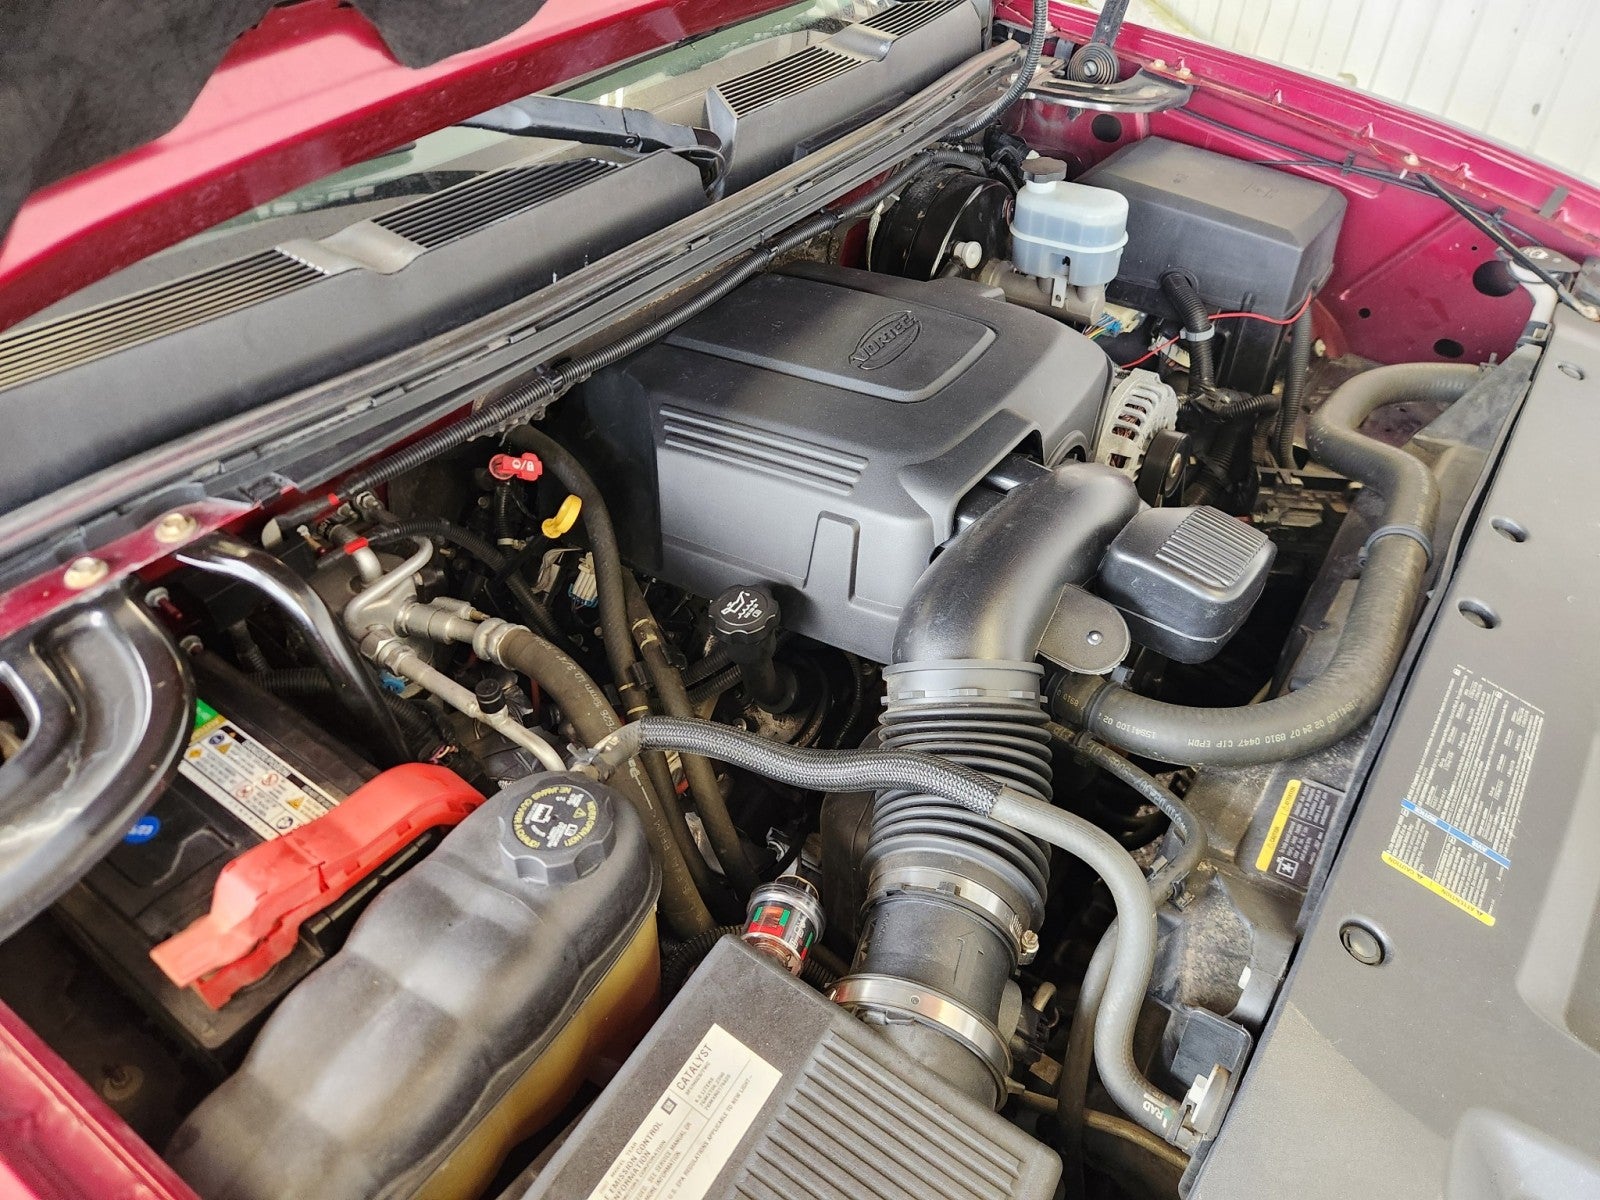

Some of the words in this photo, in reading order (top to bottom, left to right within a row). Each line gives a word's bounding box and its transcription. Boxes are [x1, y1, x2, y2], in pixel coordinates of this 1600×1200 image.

[849, 310, 917, 366] VORTEC
[1186, 739, 1211, 747] EPDM
[1287, 727, 1301, 739] 07
[1387, 856, 1414, 874] CAUTION
[1441, 888, 1474, 911] ATTENTION
[675, 1042, 714, 1091] CATALYST
[1141, 1099, 1165, 1120] RAD
[668, 1128, 687, 1151] MANUAL
[683, 1140, 708, 1176] REGULATIONS
[707, 1111, 727, 1141] APPLICABLE
[725, 1103, 734, 1112] TO
[730, 1092, 742, 1105] NEW
[607, 1154, 638, 1193] EMISSION
[634, 1119, 663, 1155] CONTROL
